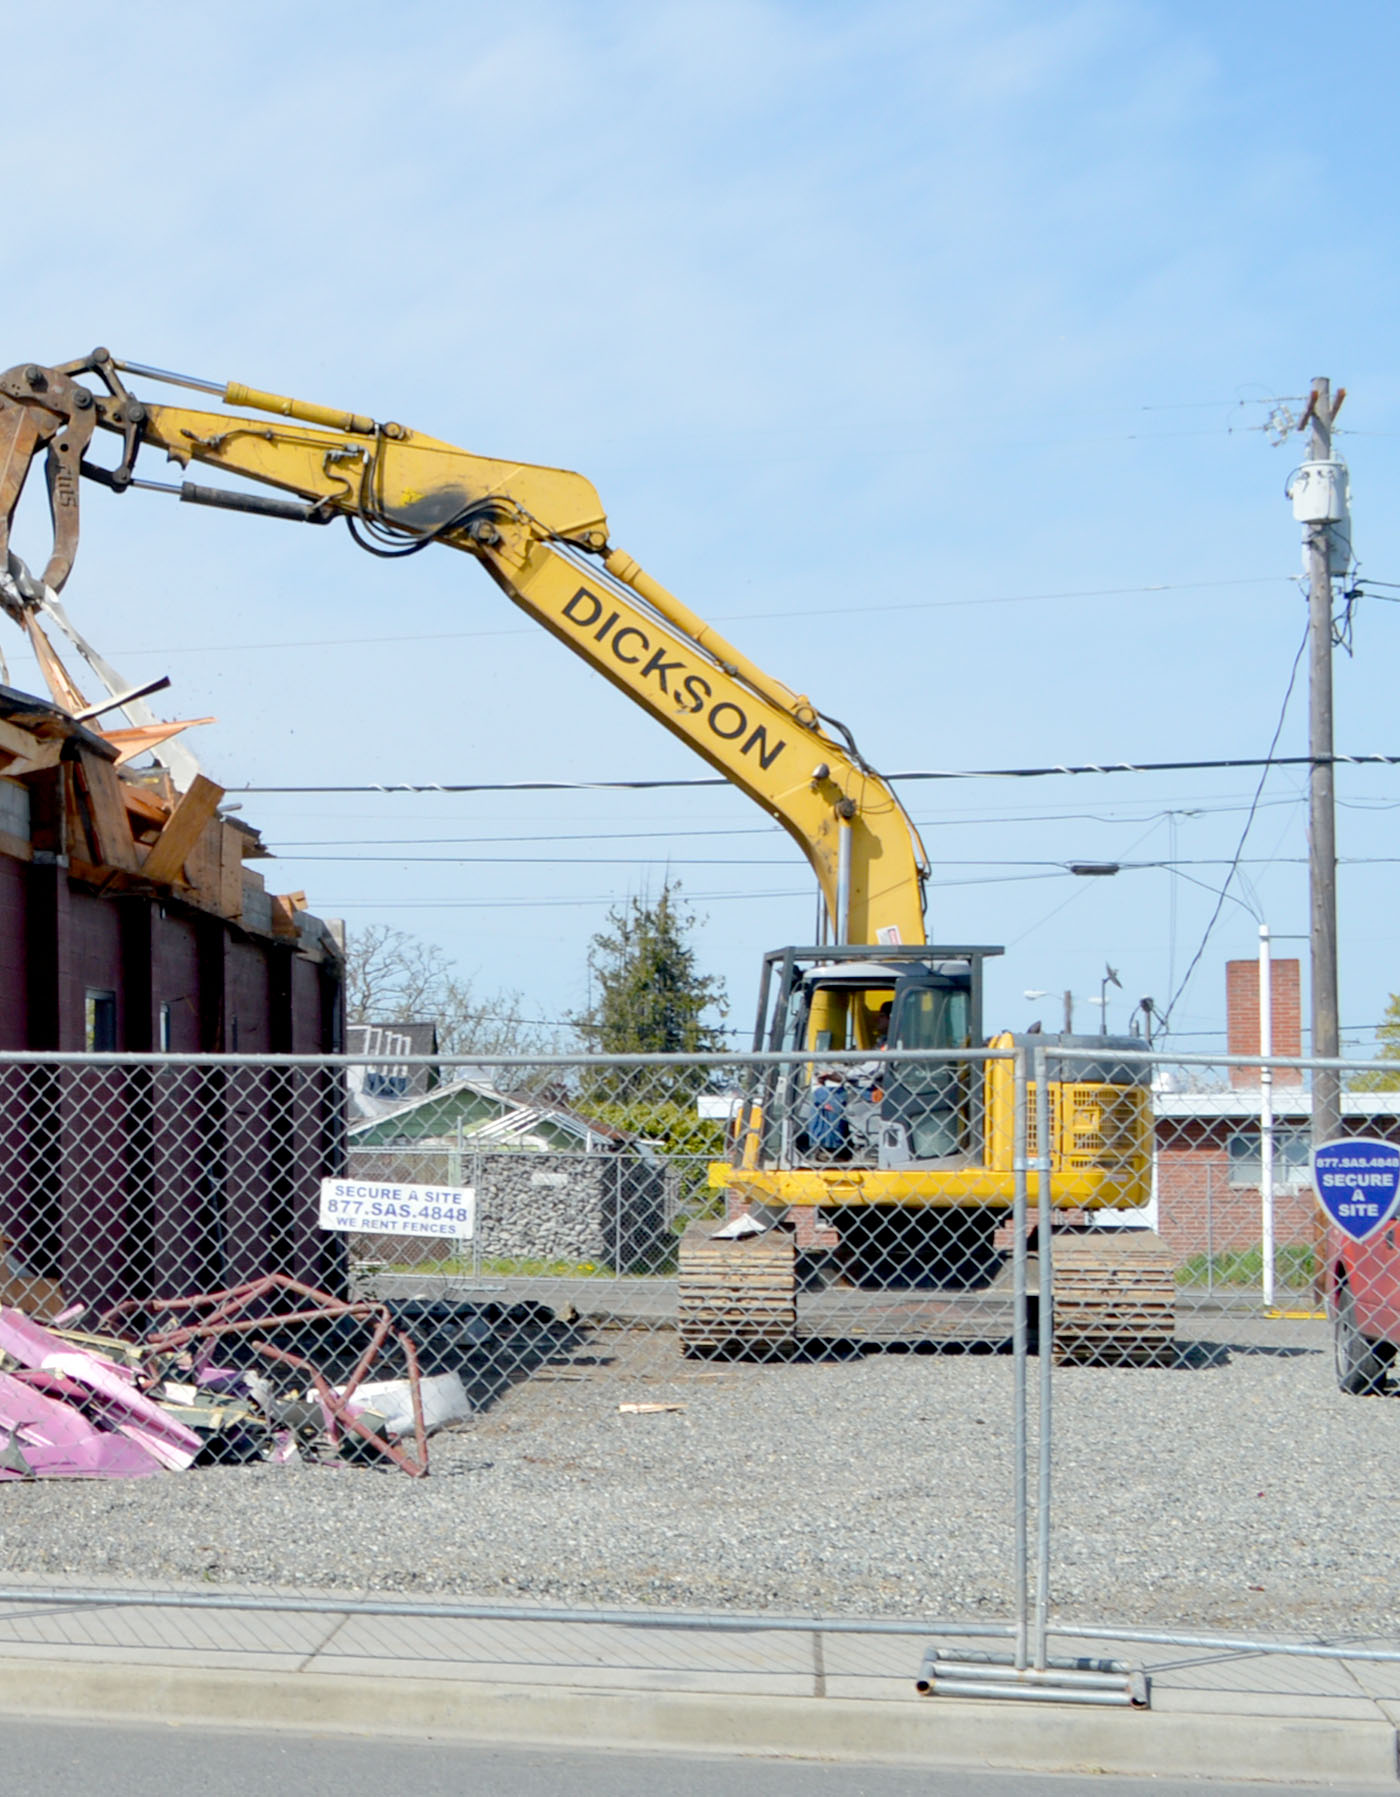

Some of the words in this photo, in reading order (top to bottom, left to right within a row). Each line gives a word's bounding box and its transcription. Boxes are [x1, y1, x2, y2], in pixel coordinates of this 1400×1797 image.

[561, 586, 787, 770] DICKSON
[1316, 1157, 1400, 1168] 877.SAS.4848
[1322, 1173, 1394, 1187] SECURE
[335, 1185, 402, 1200] SECURE
[408, 1190, 419, 1202] A
[424, 1191, 462, 1205] SITE
[1351, 1188, 1366, 1202] A
[327, 1198, 468, 1222] 877.SAS.4848
[1338, 1203, 1380, 1217] SITE
[336, 1216, 357, 1227] WE
[361, 1218, 398, 1230] RENT
[402, 1221, 457, 1234] FENCES
